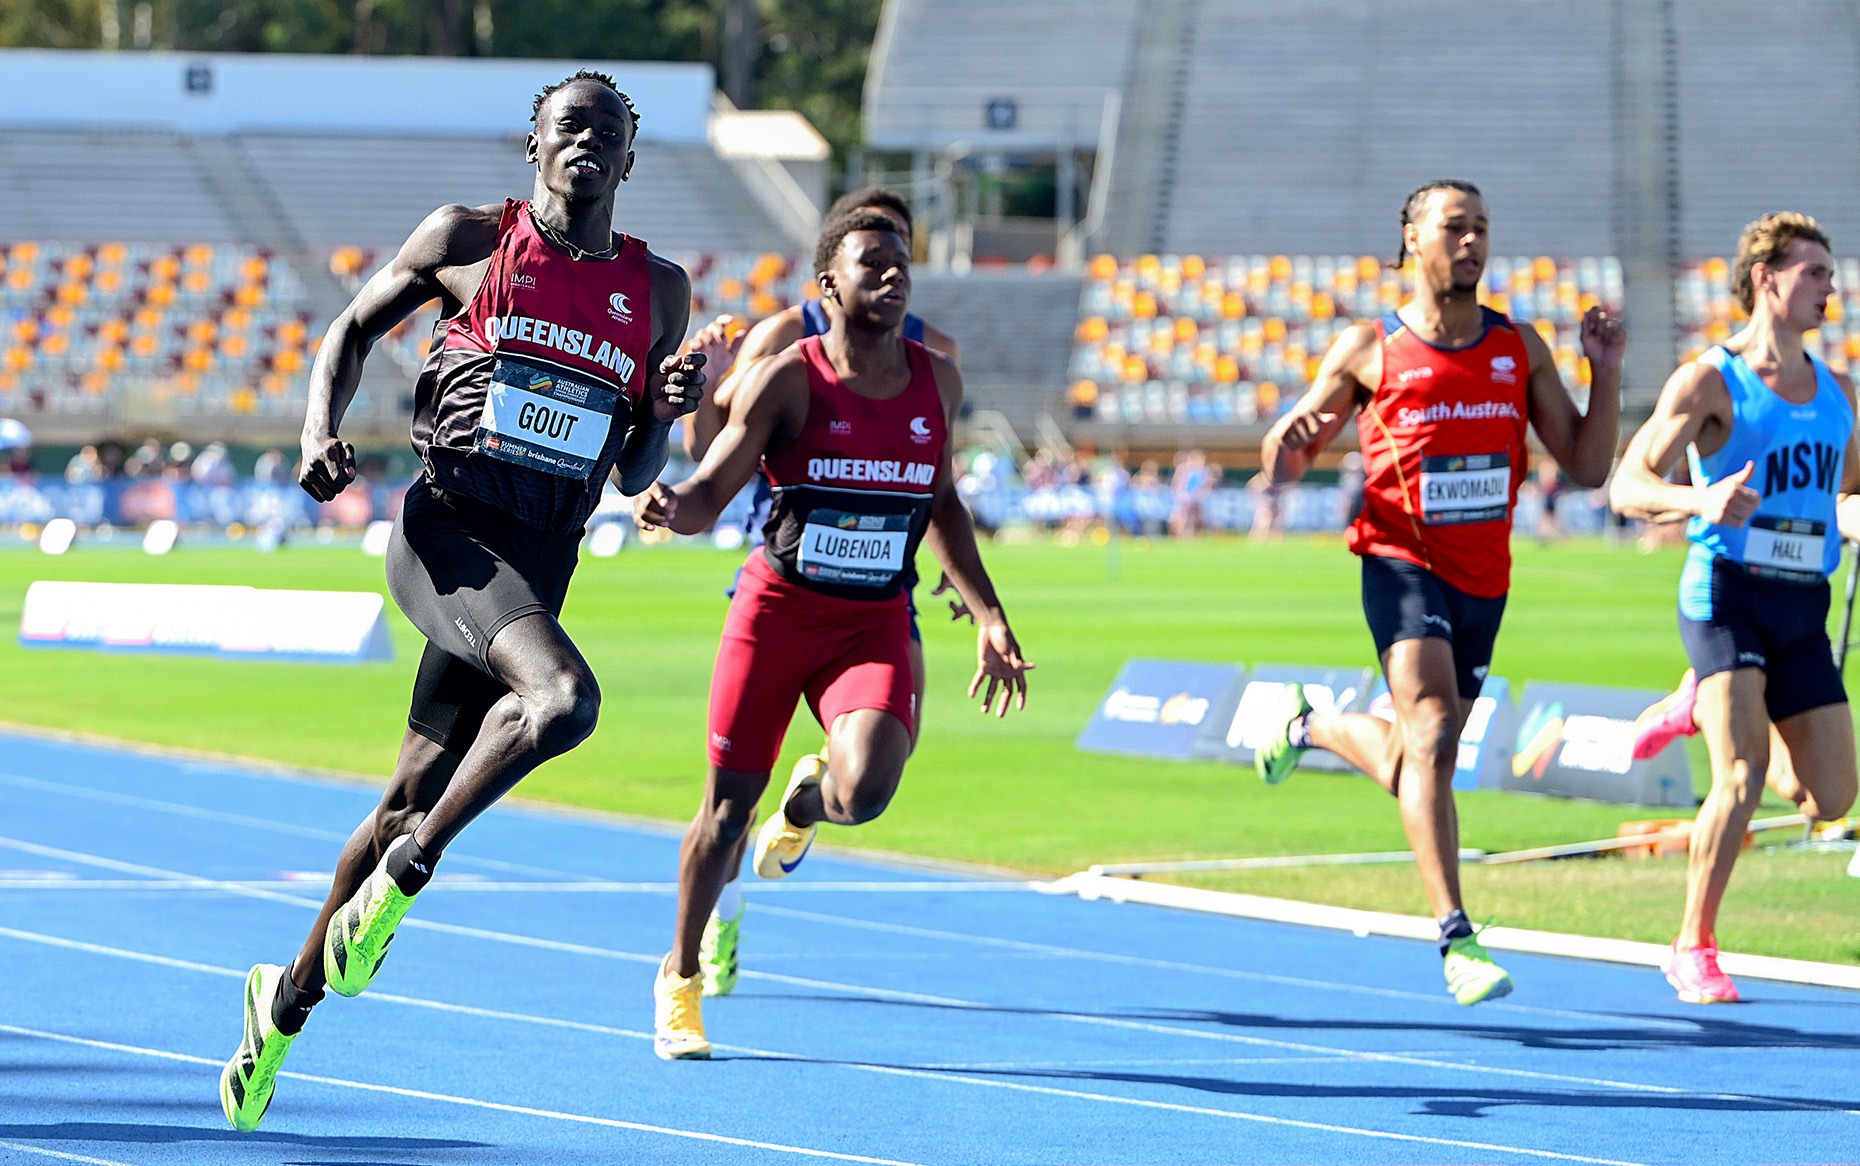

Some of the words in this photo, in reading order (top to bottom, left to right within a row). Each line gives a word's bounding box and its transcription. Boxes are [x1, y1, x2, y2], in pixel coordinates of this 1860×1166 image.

[510, 273, 537, 285] IMPI
[484, 315, 636, 384] QUEENSLAND
[555, 383, 589, 398] ATHLETICS
[556, 378, 590, 393] AUSTRALIAN
[518, 402, 579, 442] GOUT
[1397, 401, 1451, 428] South
[500, 440, 527, 453] SUMMER
[527, 449, 557, 465] brisbane
[808, 459, 935, 485] QUEENSLAND
[1763, 442, 1839, 497] NSW
[1428, 478, 1505, 500] EKWOMADU
[814, 533, 891, 560] LUBENDA
[1772, 538, 1803, 560] HALL
